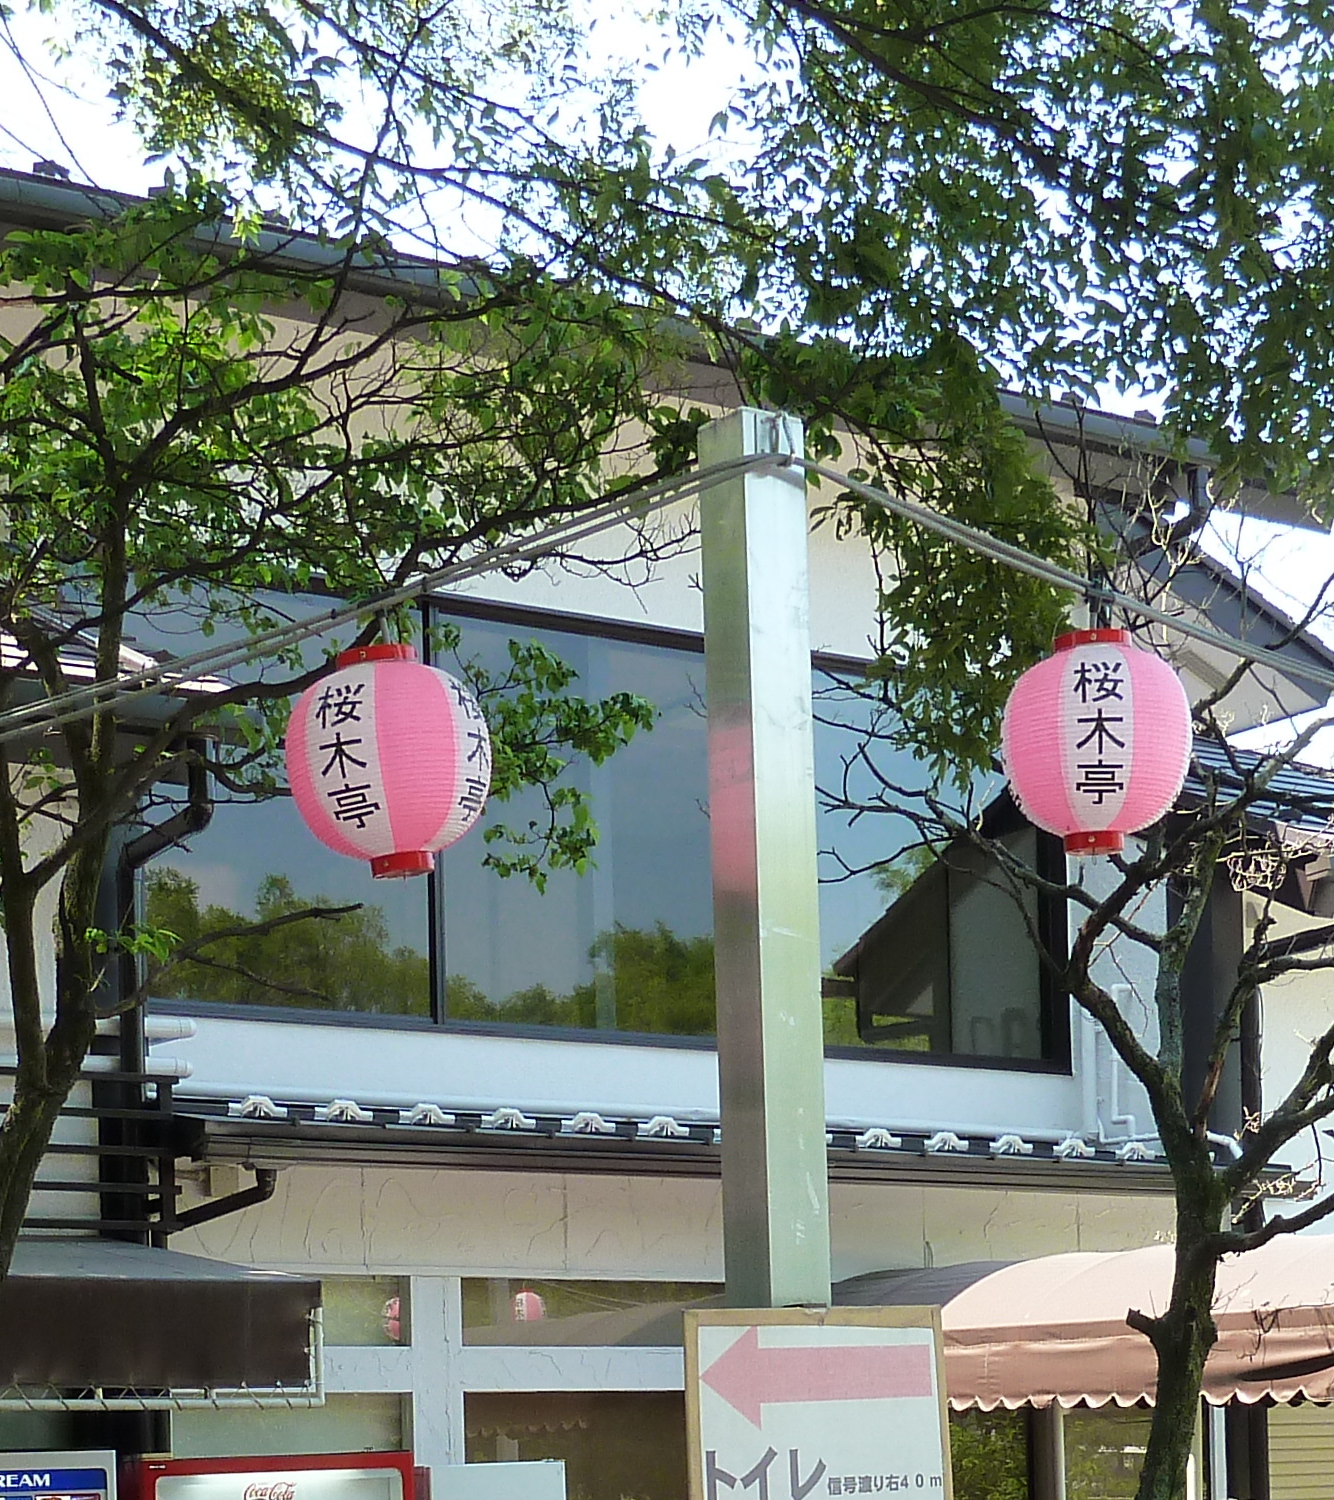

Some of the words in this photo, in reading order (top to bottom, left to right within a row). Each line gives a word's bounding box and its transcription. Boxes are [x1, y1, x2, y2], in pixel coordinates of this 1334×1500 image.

[314, 683, 381, 831] 桜木亭
[1073, 661, 1126, 805] 桜木亭
